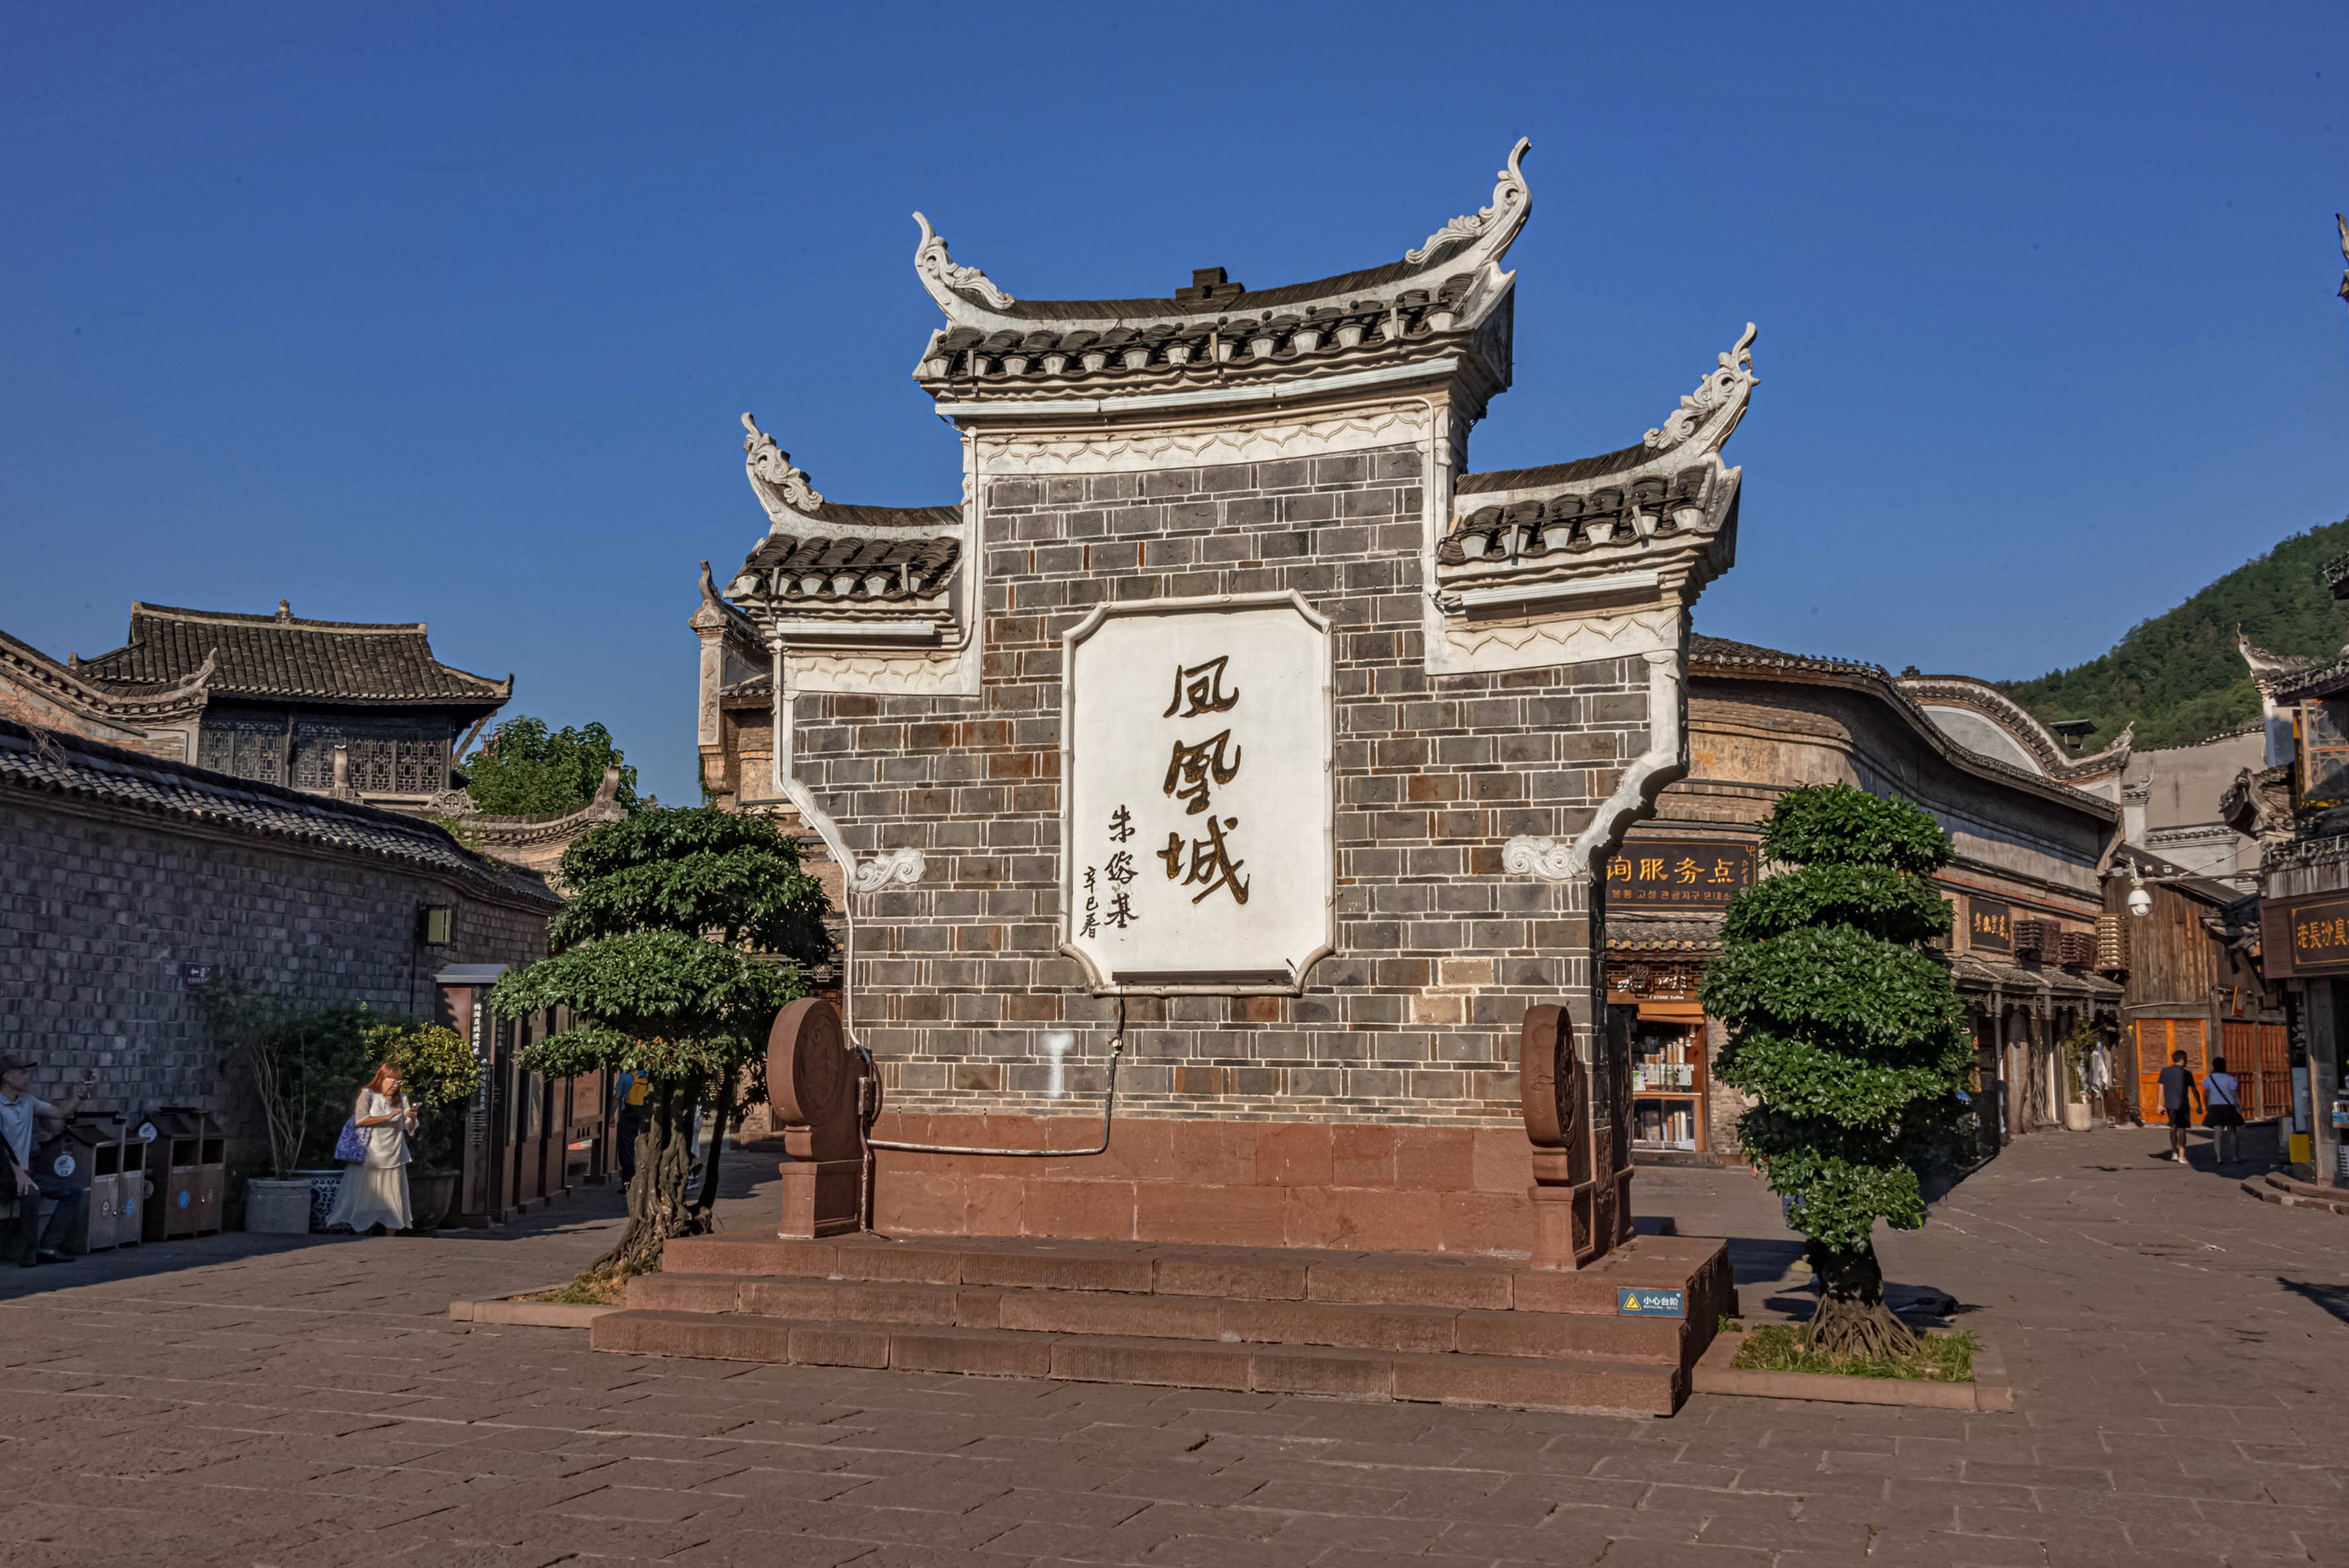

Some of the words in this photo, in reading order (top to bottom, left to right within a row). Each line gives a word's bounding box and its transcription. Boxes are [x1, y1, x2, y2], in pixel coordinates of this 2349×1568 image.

[1157, 655, 1250, 906] 凤凰城
[1606, 855, 1735, 884] 询服务点
[1643, 1296, 1678, 1307] 小心台阶
